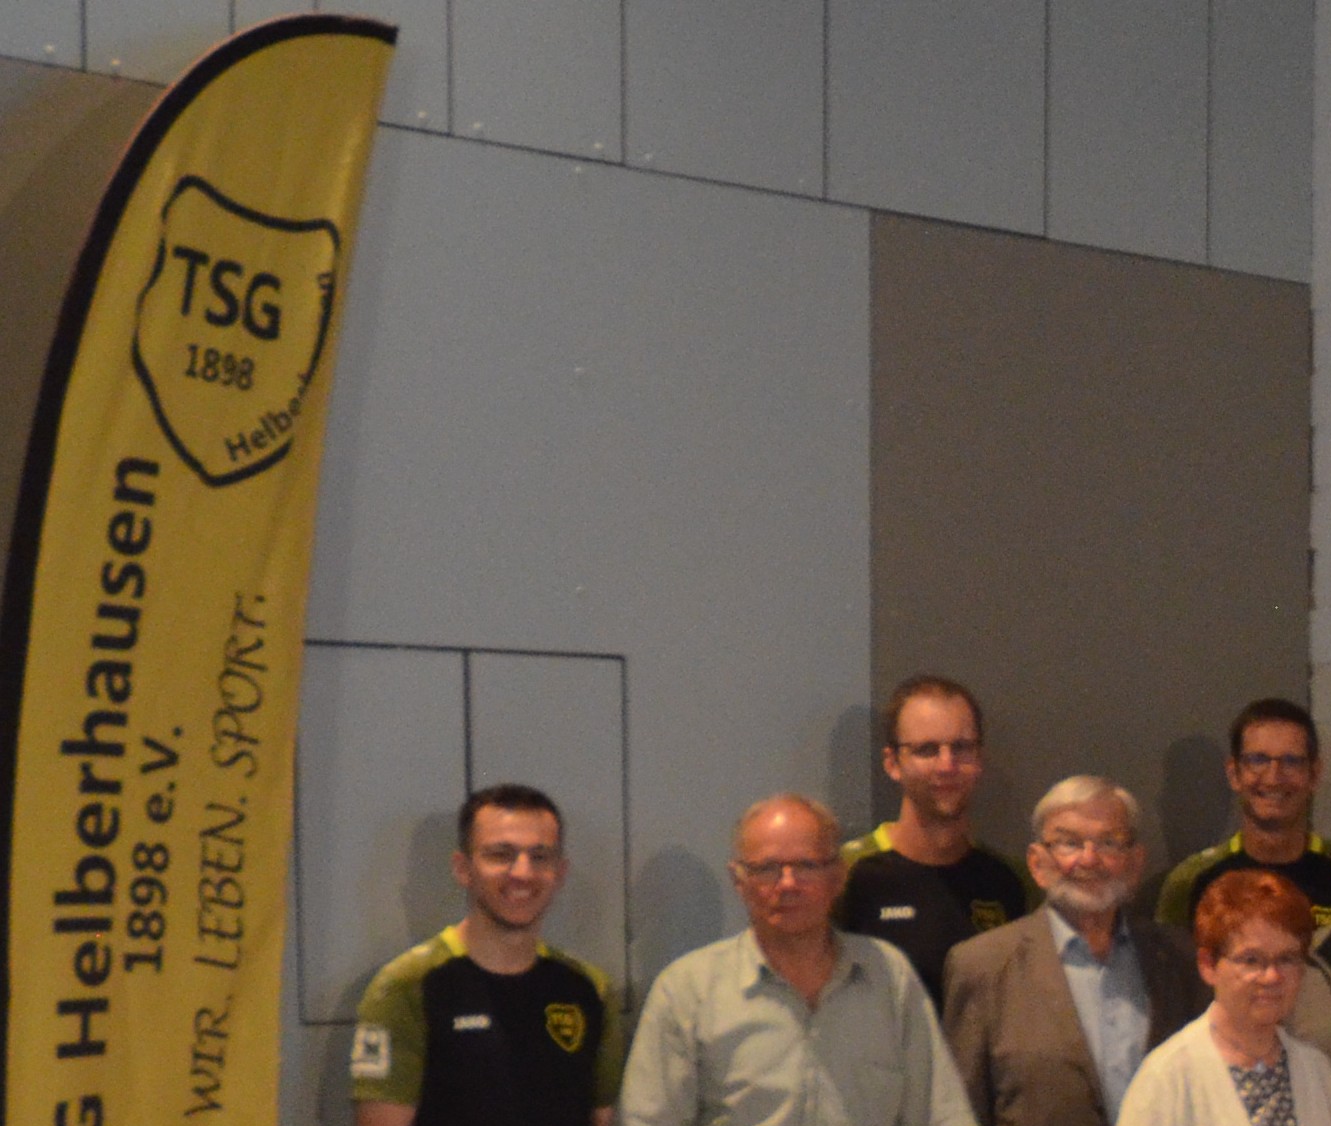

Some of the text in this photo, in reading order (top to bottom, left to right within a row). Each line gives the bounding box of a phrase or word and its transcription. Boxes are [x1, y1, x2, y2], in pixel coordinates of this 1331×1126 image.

[173, 245, 282, 341] TSG
[184, 343, 255, 391] 1898
[53, 456, 160, 1060] Helberhausen
[209, 593, 267, 778] SPORT.
[125, 723, 185, 973] 1898 e.V.
[194, 796, 247, 970] LEBEN.
